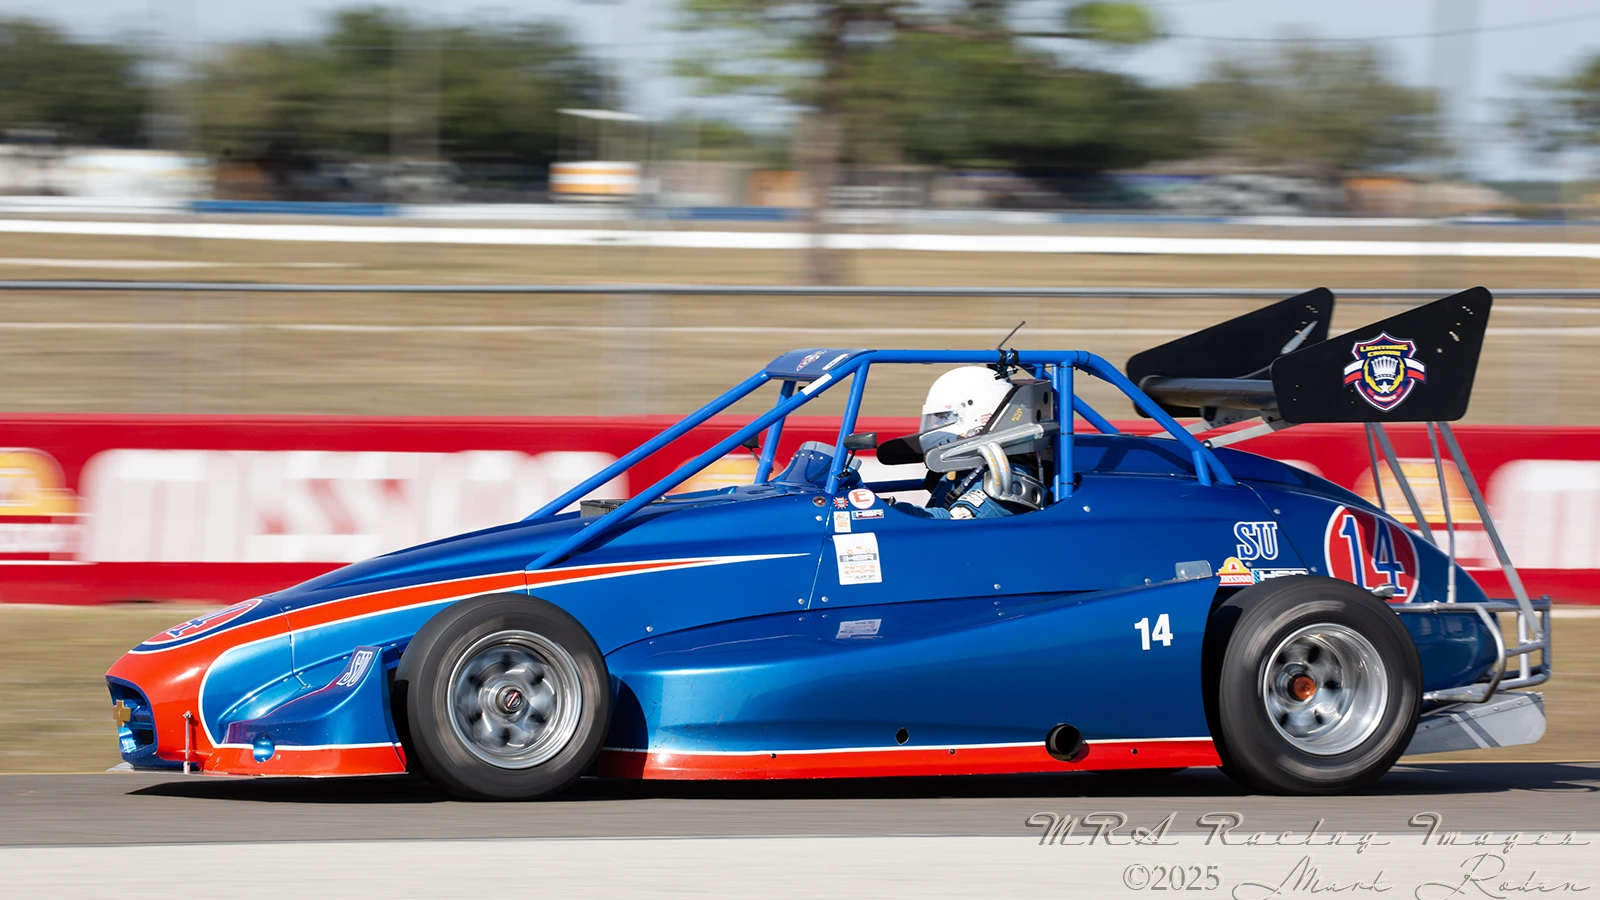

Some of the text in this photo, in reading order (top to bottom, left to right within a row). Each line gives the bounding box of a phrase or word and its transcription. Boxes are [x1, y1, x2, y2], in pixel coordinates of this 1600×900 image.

[852, 490, 870, 503] E
[1233, 521, 1278, 561] SU
[1338, 514, 1408, 597] 14
[1134, 613, 1174, 651] 14
[336, 650, 374, 687] SU
